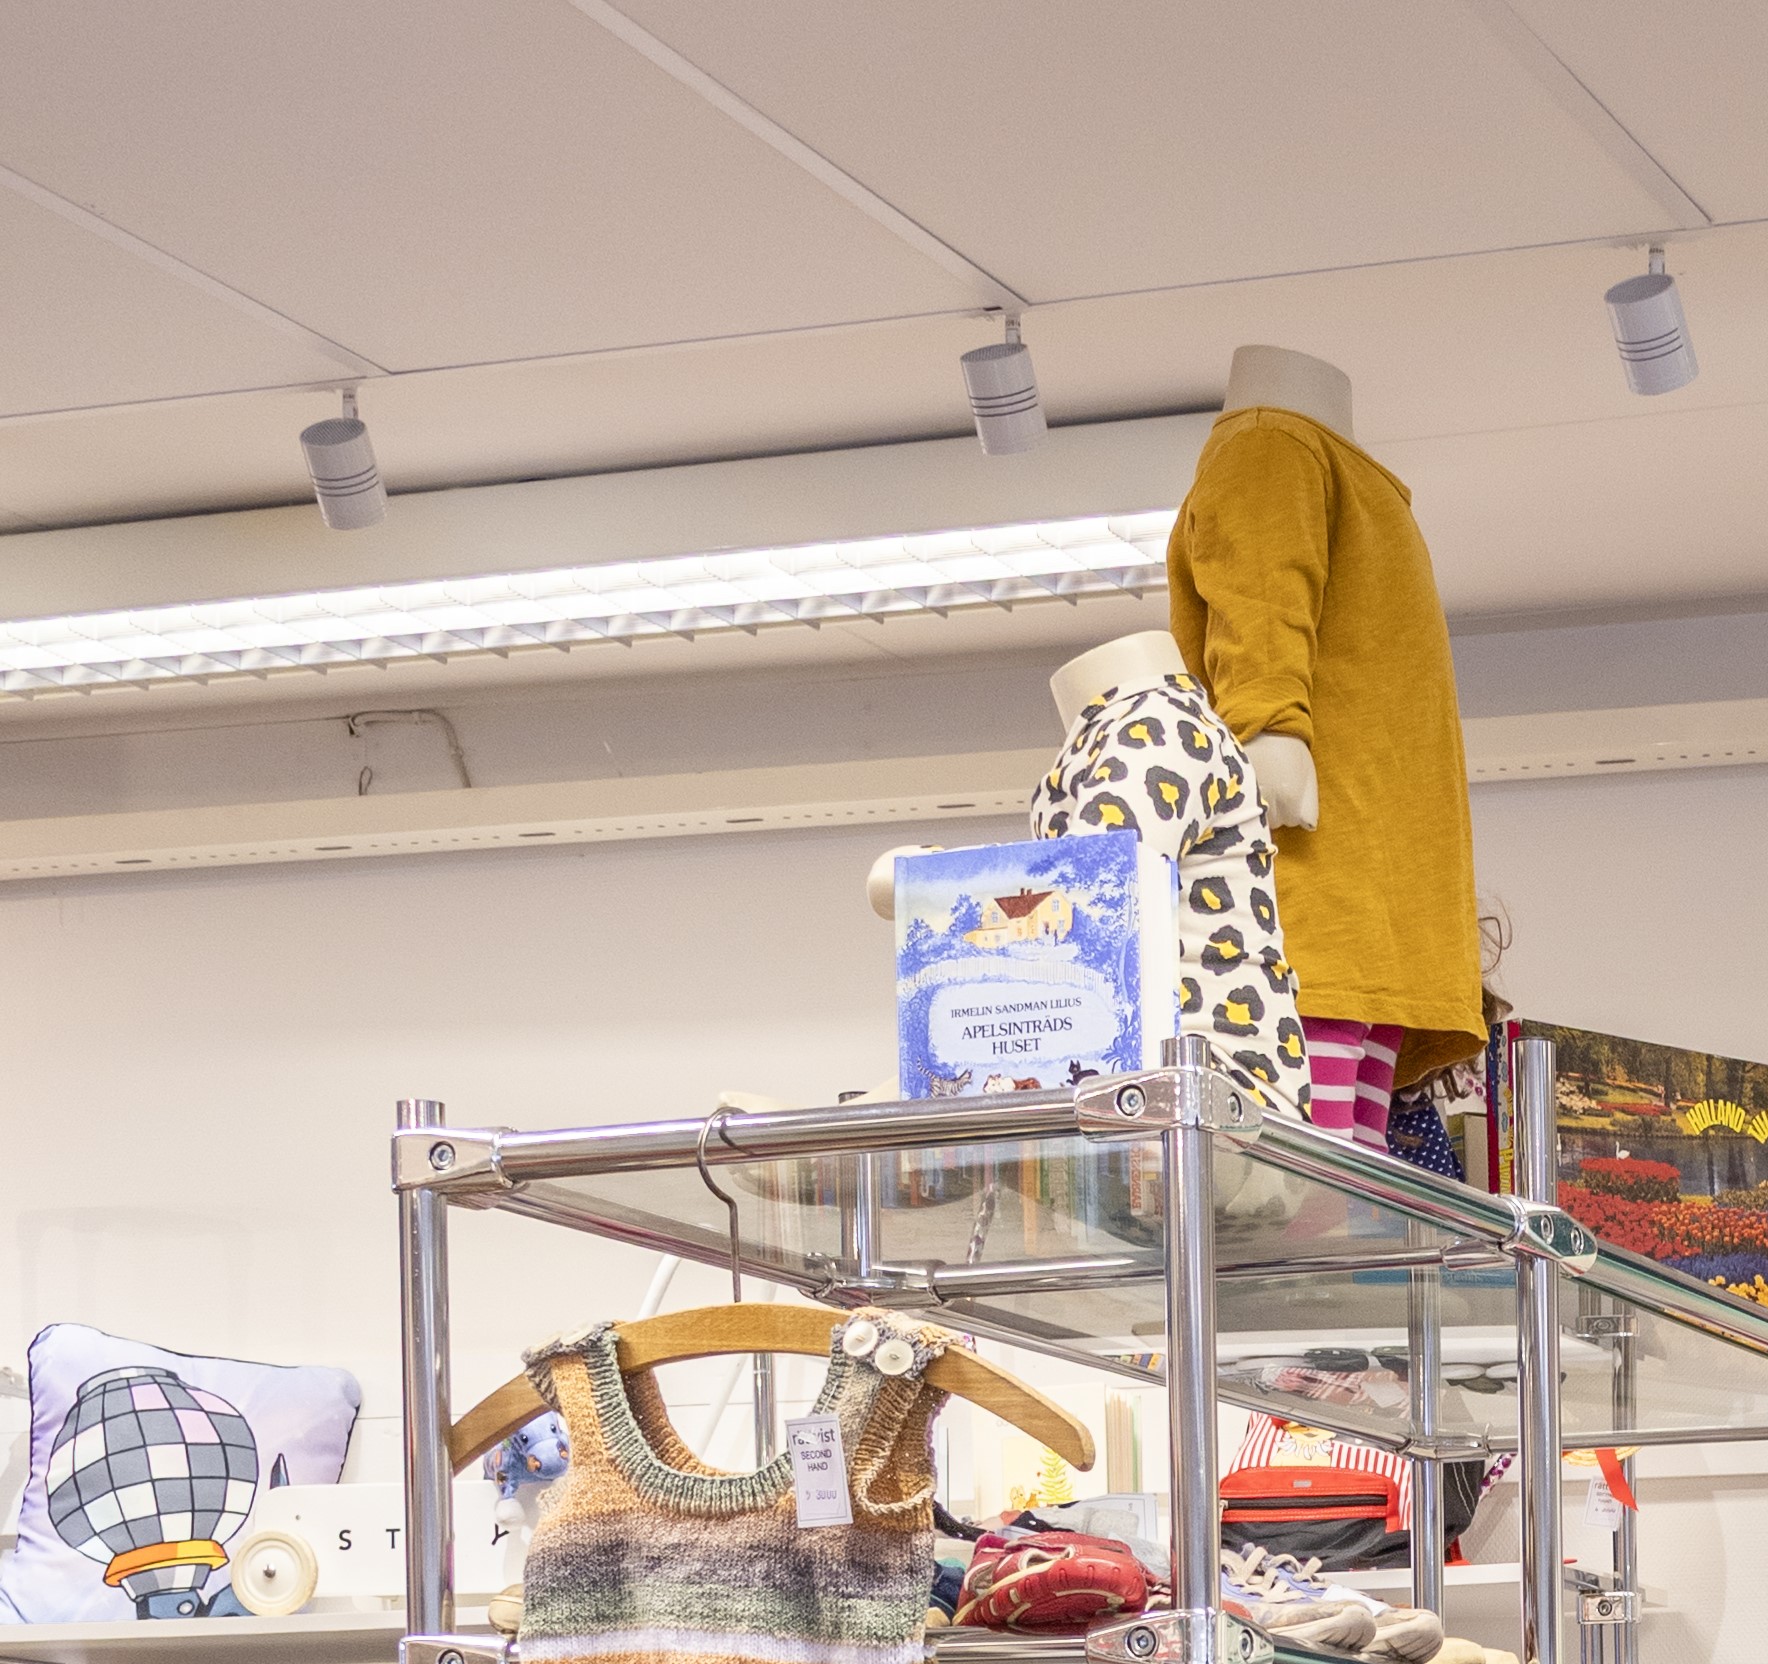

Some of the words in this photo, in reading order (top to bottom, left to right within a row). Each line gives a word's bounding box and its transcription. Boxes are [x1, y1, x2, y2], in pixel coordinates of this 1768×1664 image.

[951, 1006, 993, 1018] IRMELIN
[995, 1000, 1048, 1014] SANDMAN
[1050, 997, 1082, 1009] LILIUS
[962, 1015, 1073, 1040] APELSINTRÄDS
[992, 1038, 1041, 1055] HUSET
[1686, 1099, 1745, 1135] HOLLAND
[800, 1449, 832, 1461] SECOND
[808, 1462, 829, 1472] HAND
